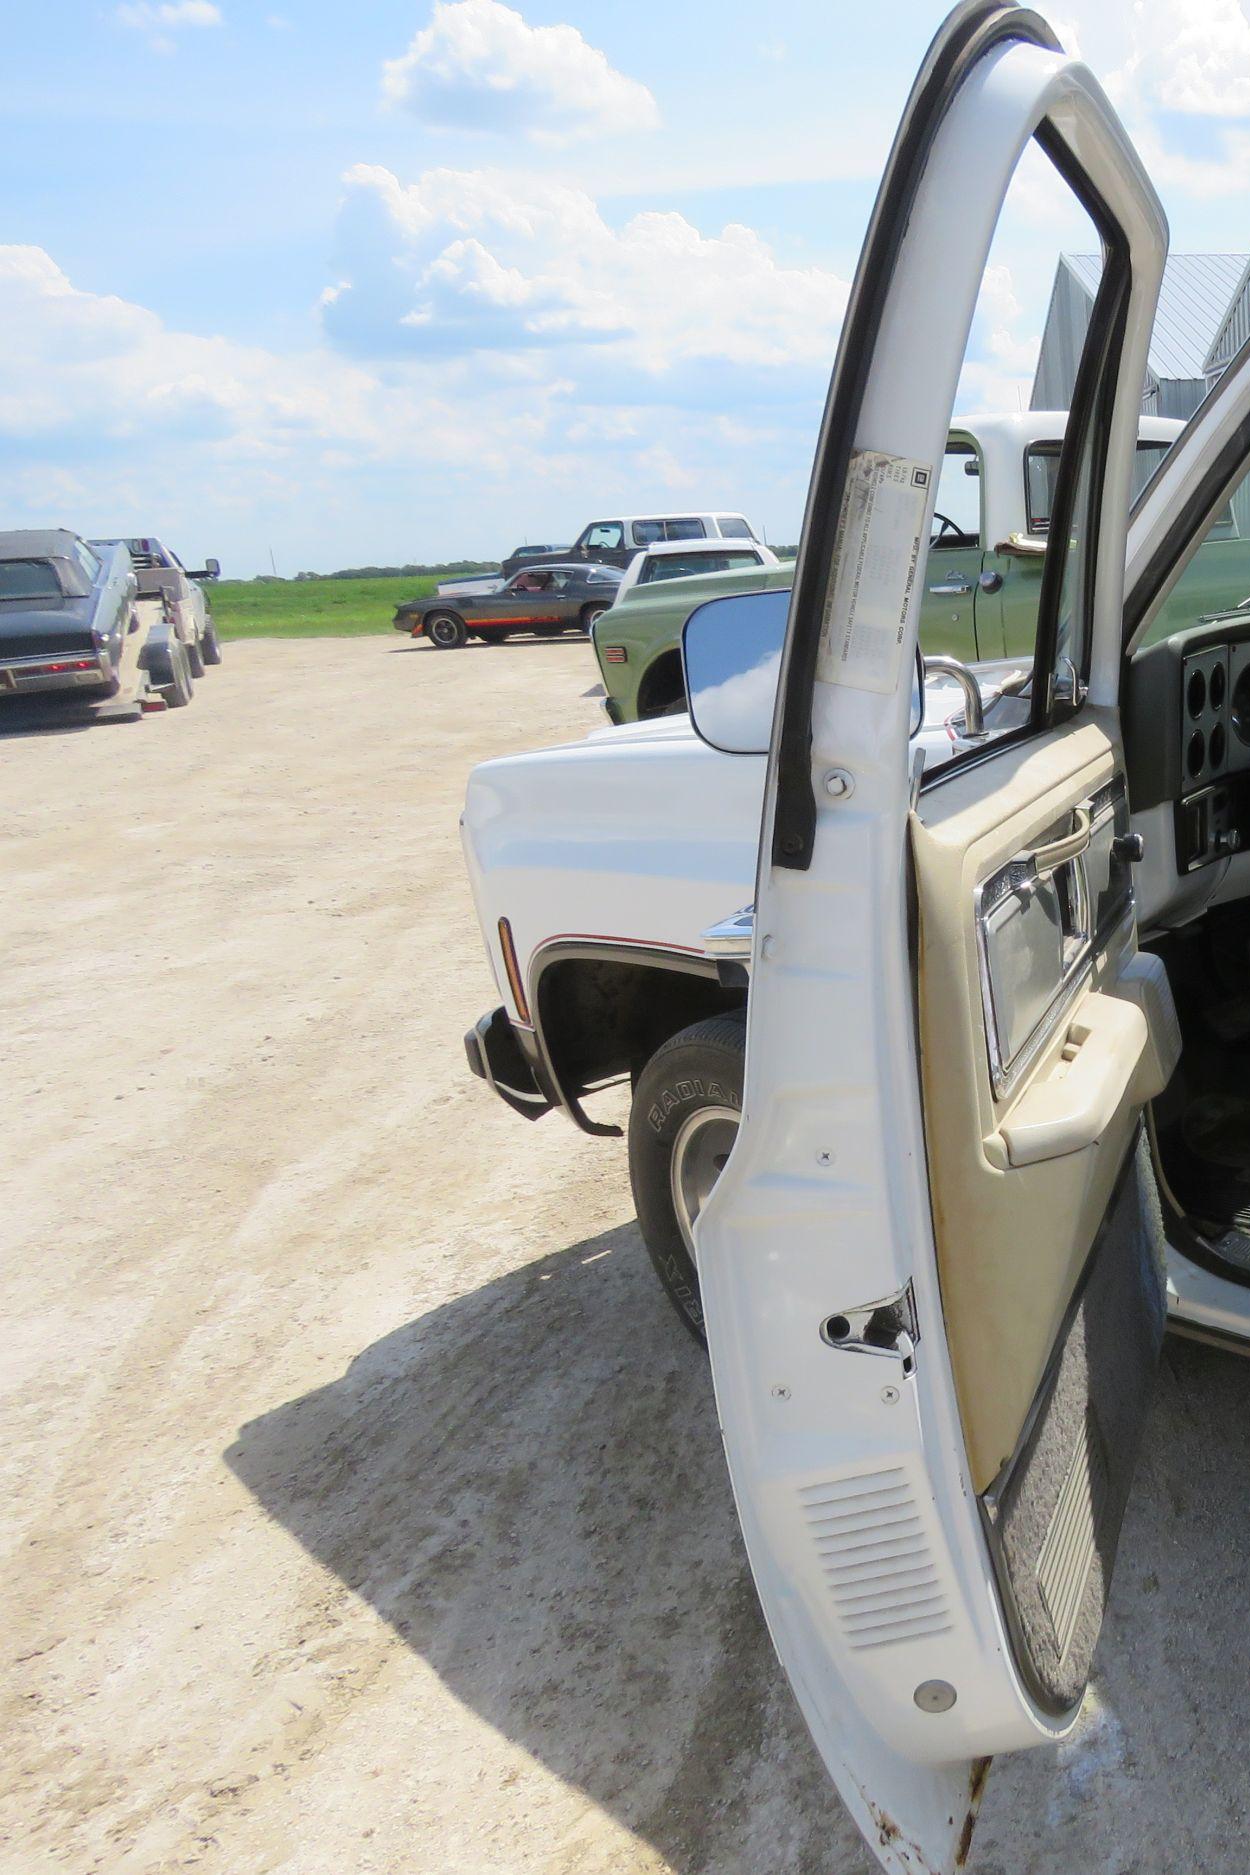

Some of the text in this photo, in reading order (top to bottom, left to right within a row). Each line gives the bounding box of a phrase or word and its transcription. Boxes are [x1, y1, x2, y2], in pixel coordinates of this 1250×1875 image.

[909, 553, 917, 563] BY
[903, 565, 915, 595] GENERAL
[898, 596, 909, 624] MOTORS
[648, 1079, 741, 1133] RADIAL
